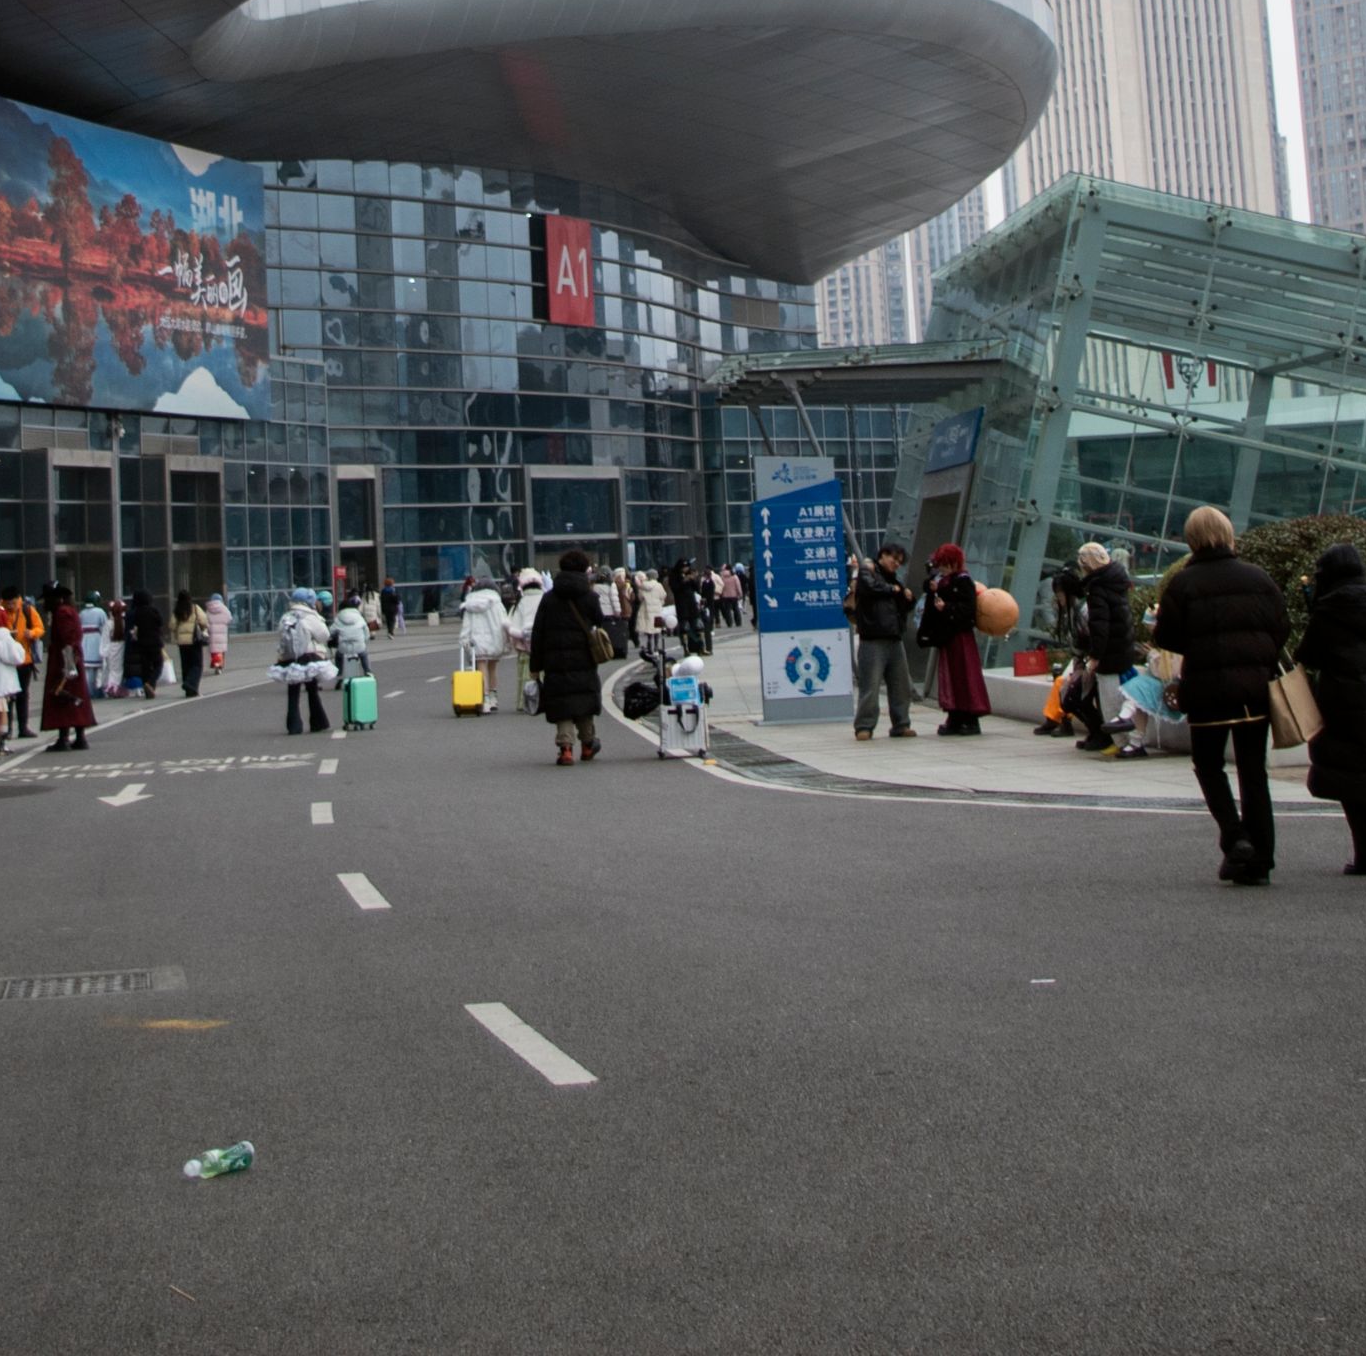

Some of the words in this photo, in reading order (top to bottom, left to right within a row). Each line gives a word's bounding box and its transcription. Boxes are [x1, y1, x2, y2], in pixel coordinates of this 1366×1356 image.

[189, 187, 244, 237] 湖北
[556, 244, 589, 299] A1
[799, 505, 836, 518] A1展馆
[805, 568, 839, 581] 地铁站
[794, 589, 842, 602] A2停车区
